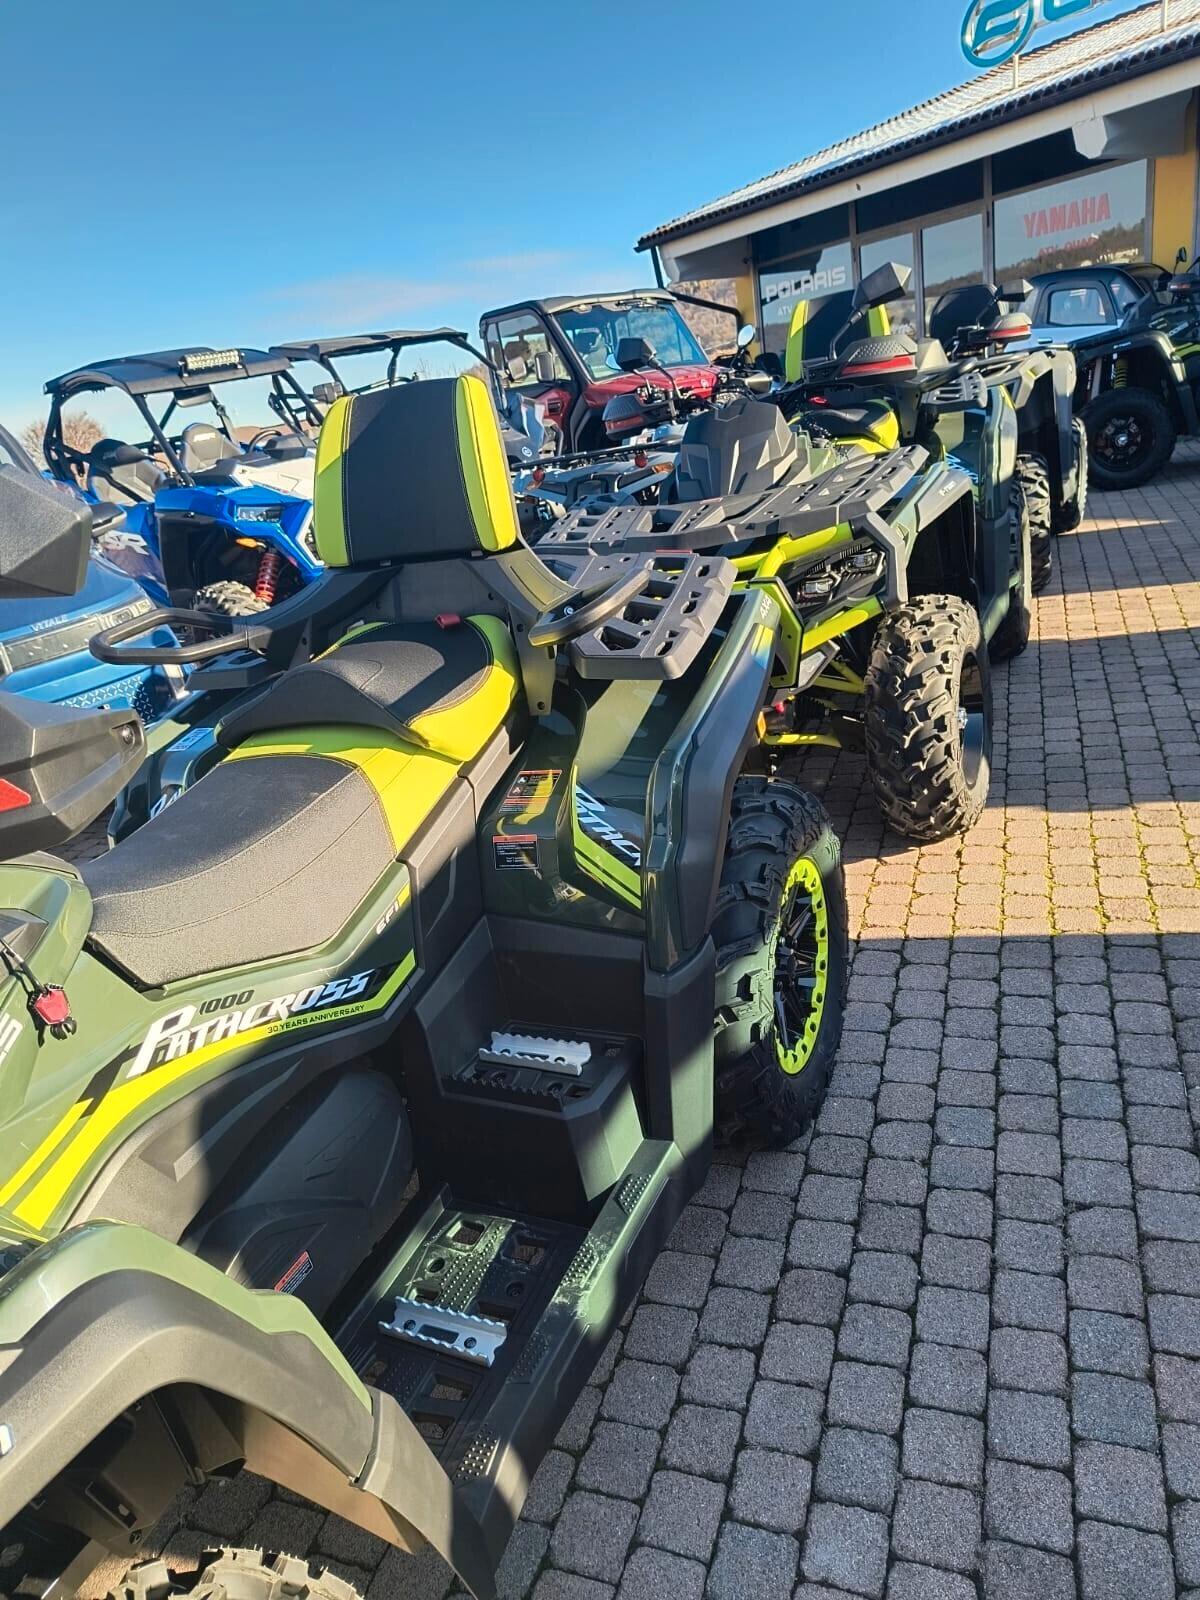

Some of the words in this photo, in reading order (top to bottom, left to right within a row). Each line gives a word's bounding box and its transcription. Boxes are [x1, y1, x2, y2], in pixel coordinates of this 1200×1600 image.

[1024, 193, 1110, 239] YAMAHA
[766, 266, 845, 301] POLARIS
[376, 900, 399, 935] EFI
[199, 989, 255, 1015] 1000
[267, 1025, 280, 1034] 30
[280, 1017, 308, 1031] YEARS
[309, 1004, 365, 1023] ANNIVERSARY
[126, 968, 376, 1079] PATHCROSS
